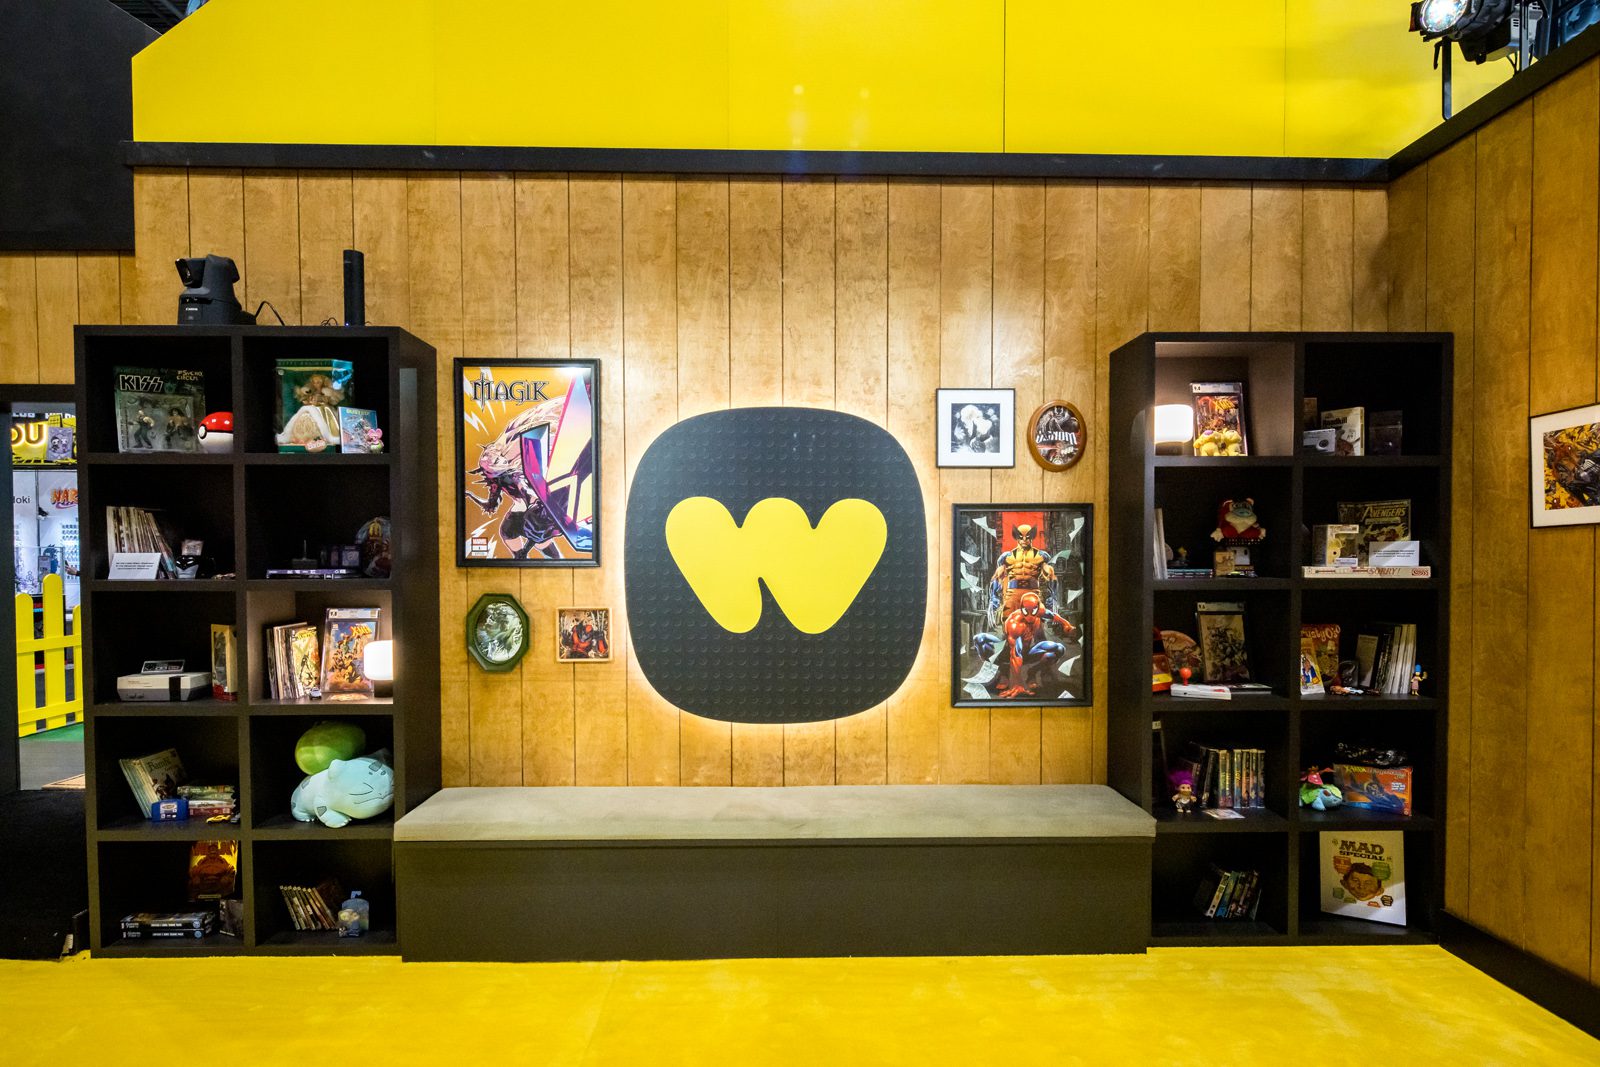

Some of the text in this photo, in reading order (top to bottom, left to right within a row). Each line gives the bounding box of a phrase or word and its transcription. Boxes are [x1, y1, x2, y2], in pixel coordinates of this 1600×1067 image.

[119, 374, 164, 393] KISS
[470, 373, 550, 407] MAGIK
[1339, 839, 1385, 855] MAD
[1339, 850, 1386, 861] SPECIAL
